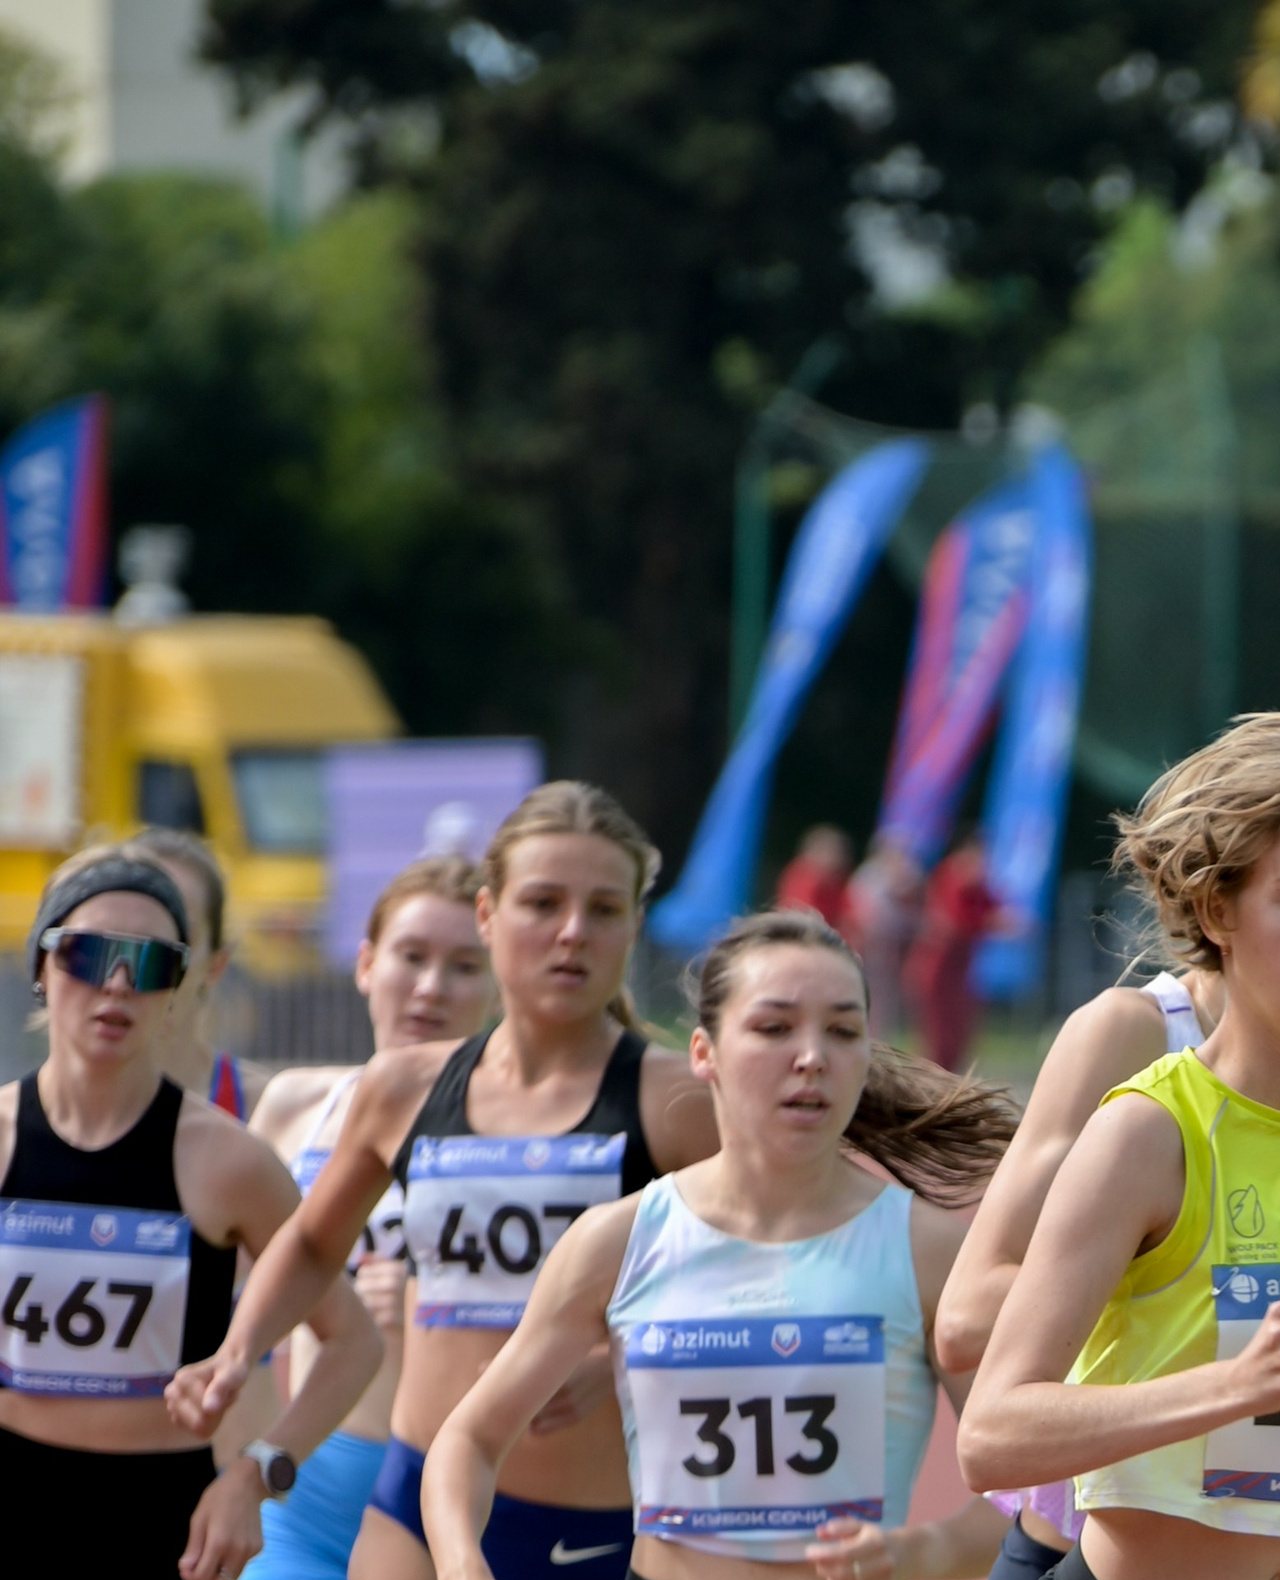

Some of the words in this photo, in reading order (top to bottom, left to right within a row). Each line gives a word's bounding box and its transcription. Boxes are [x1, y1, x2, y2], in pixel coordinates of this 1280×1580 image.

[438, 1206, 589, 1275] 407
[3, 1274, 153, 1349] 467
[673, 1327, 750, 1349] azimut
[679, 1395, 839, 1478] 313
[692, 1510, 765, 1526] КУБОК
[767, 1509, 827, 1525] СОЧИ
